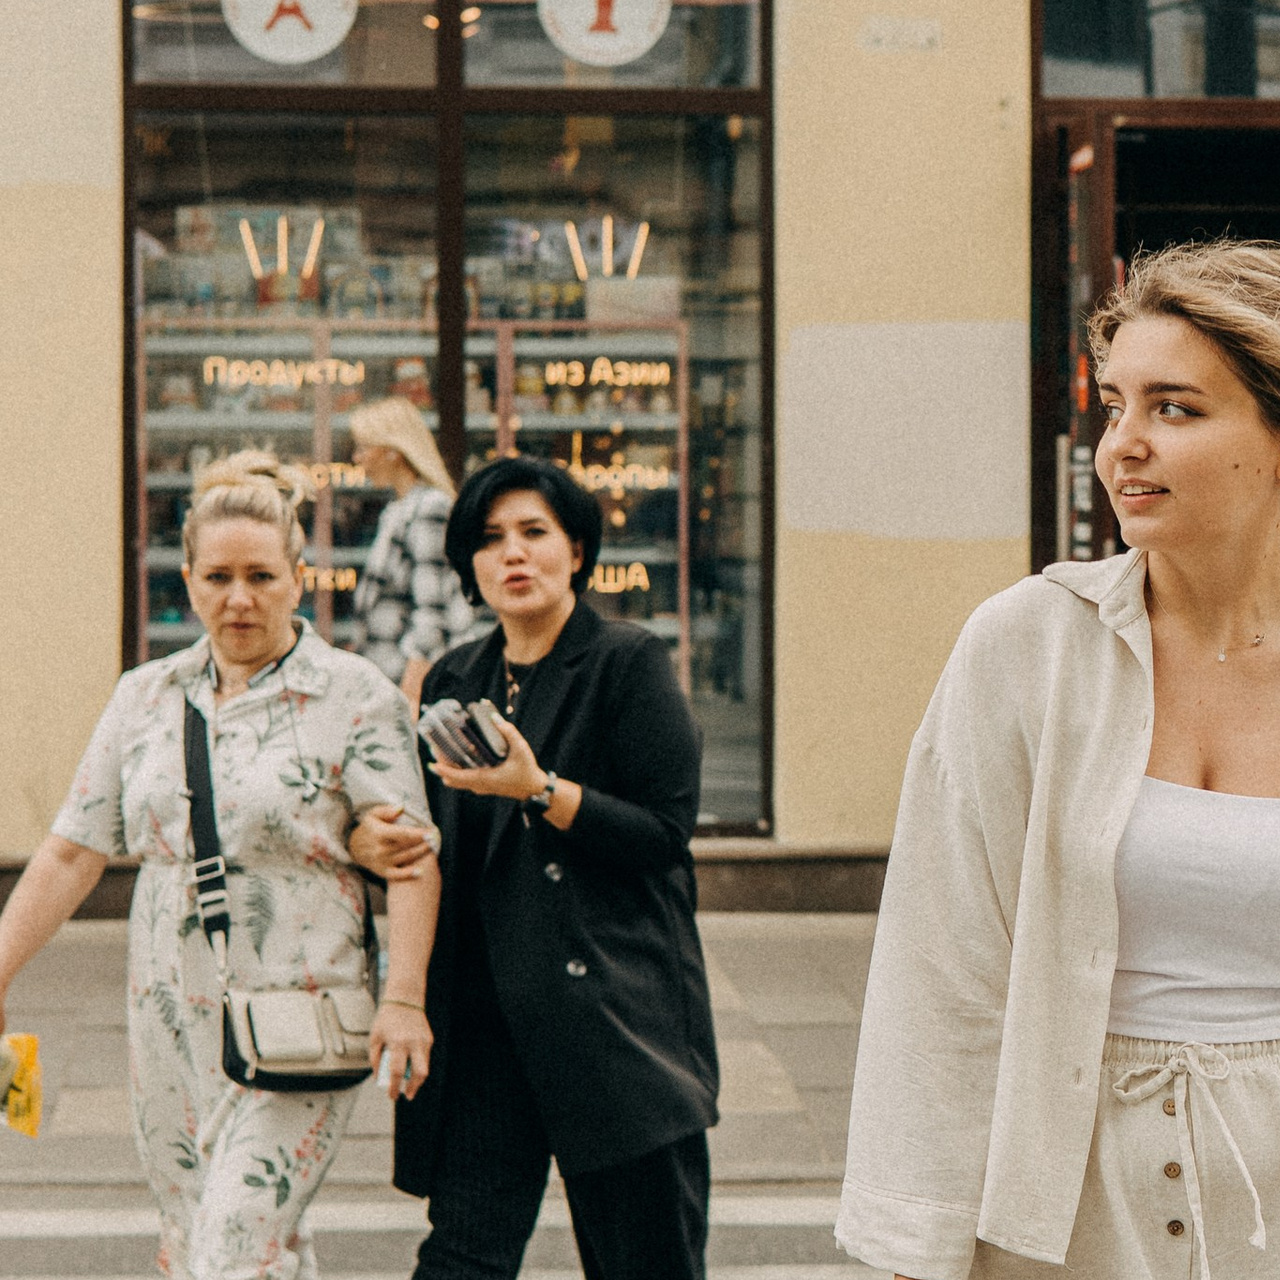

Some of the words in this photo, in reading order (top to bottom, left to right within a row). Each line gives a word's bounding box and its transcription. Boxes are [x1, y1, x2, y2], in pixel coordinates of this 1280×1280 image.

[203, 355, 365, 392] Продукты
[545, 360, 585, 387] из
[589, 356, 671, 387] Азии
[588, 561, 651, 594] ША
